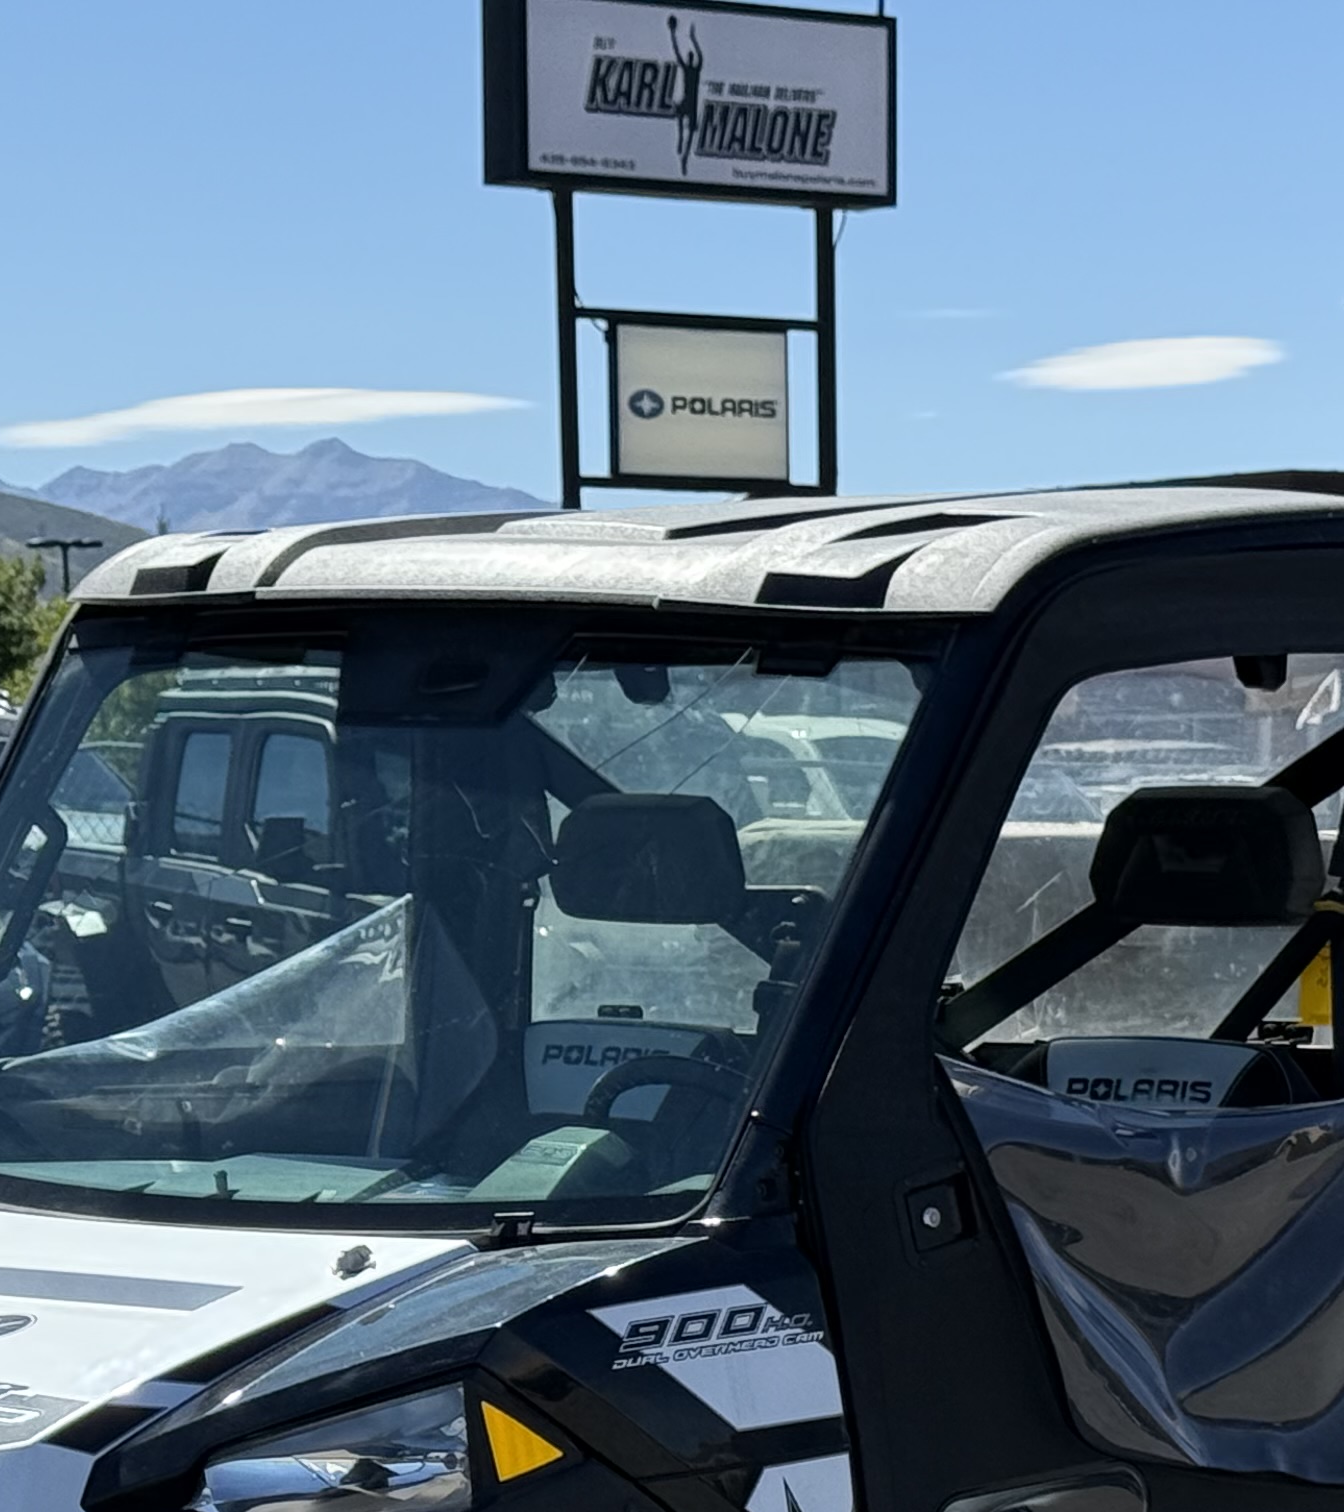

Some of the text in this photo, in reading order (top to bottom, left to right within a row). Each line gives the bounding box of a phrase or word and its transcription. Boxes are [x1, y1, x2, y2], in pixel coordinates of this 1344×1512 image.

[585, 55, 677, 116] KARL
[695, 100, 836, 164] MALONE
[670, 396, 777, 418] POLARIS
[541, 1044, 670, 1067] POLAR
[1066, 1077, 1212, 1103] POLARIS
[619, 1302, 768, 1353] 900
[611, 1330, 824, 1370] DUAL OVERHEAD CAM
